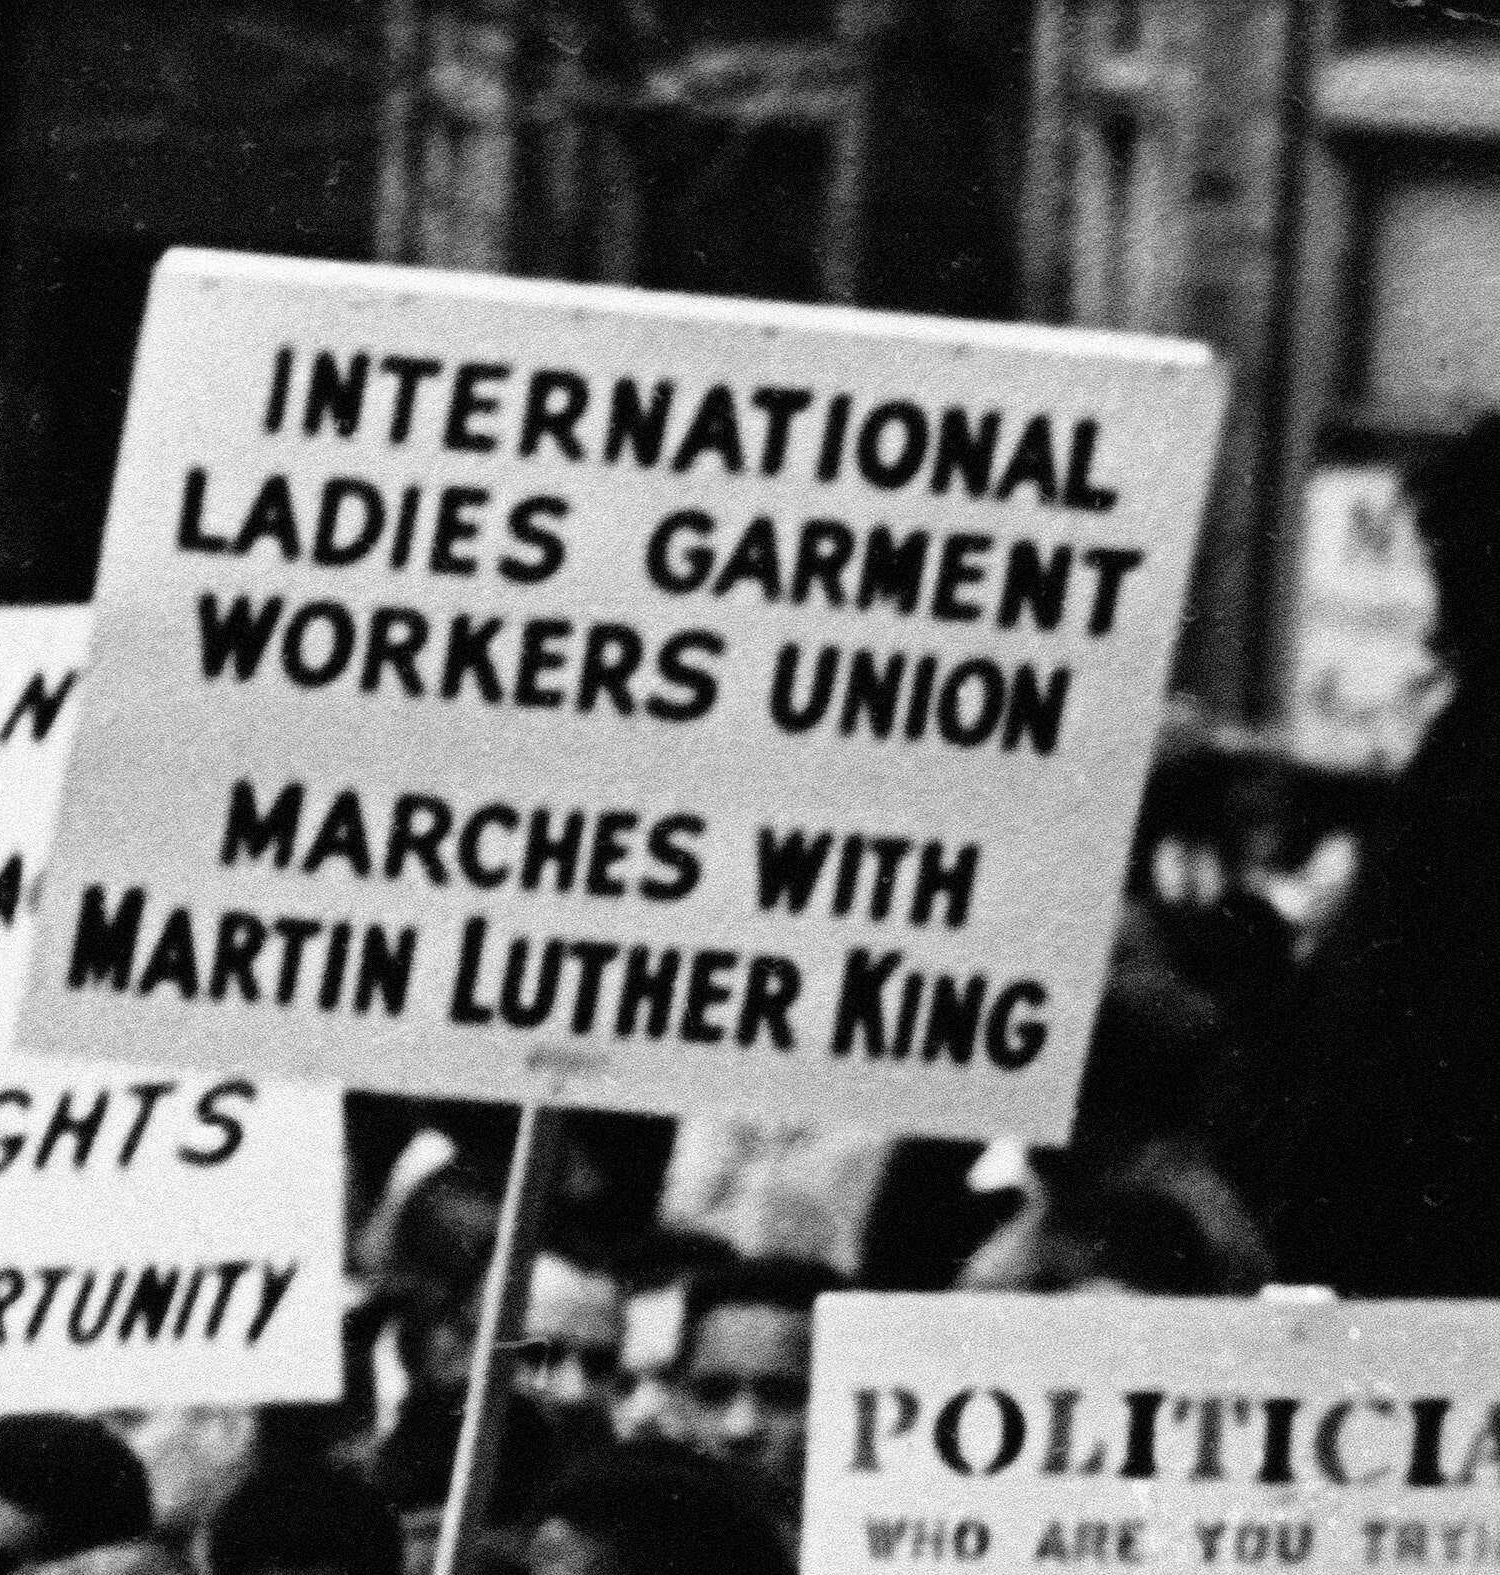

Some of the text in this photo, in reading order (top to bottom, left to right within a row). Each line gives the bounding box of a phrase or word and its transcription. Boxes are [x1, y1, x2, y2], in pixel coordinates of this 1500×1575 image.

[262, 345, 1122, 513] INTERNATIONAL
[176, 466, 569, 586] LADIES
[645, 508, 1146, 639] GARMENT
[196, 591, 1075, 759] WORKERS UNION
[220, 779, 980, 931] MARCHES WITH
[66, 886, 1049, 1073] MARTIN LUTHER KING
[863, 1518, 991, 1563] WHO
[1034, 1518, 1144, 1565] ARE
[1198, 1520, 1315, 1566] YOU
